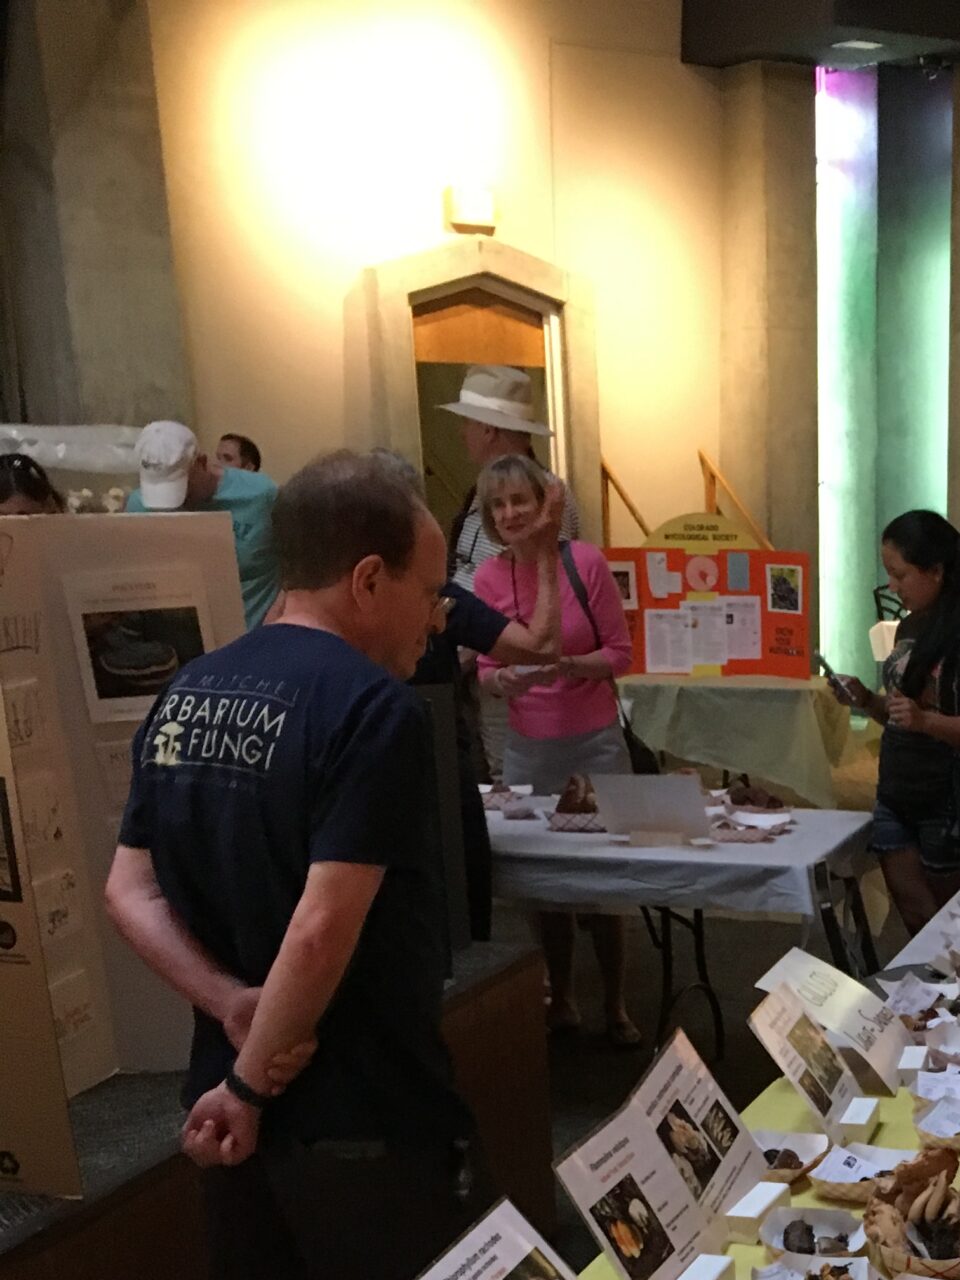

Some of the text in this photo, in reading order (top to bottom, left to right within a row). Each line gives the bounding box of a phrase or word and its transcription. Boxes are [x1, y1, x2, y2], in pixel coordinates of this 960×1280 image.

[664, 533, 738, 542] MYCOLOGICAL SOCIETY
[683, 524, 719, 532] COLORADO
[155, 694, 287, 737] RBARIUM
[187, 728, 275, 771] FUNGI
